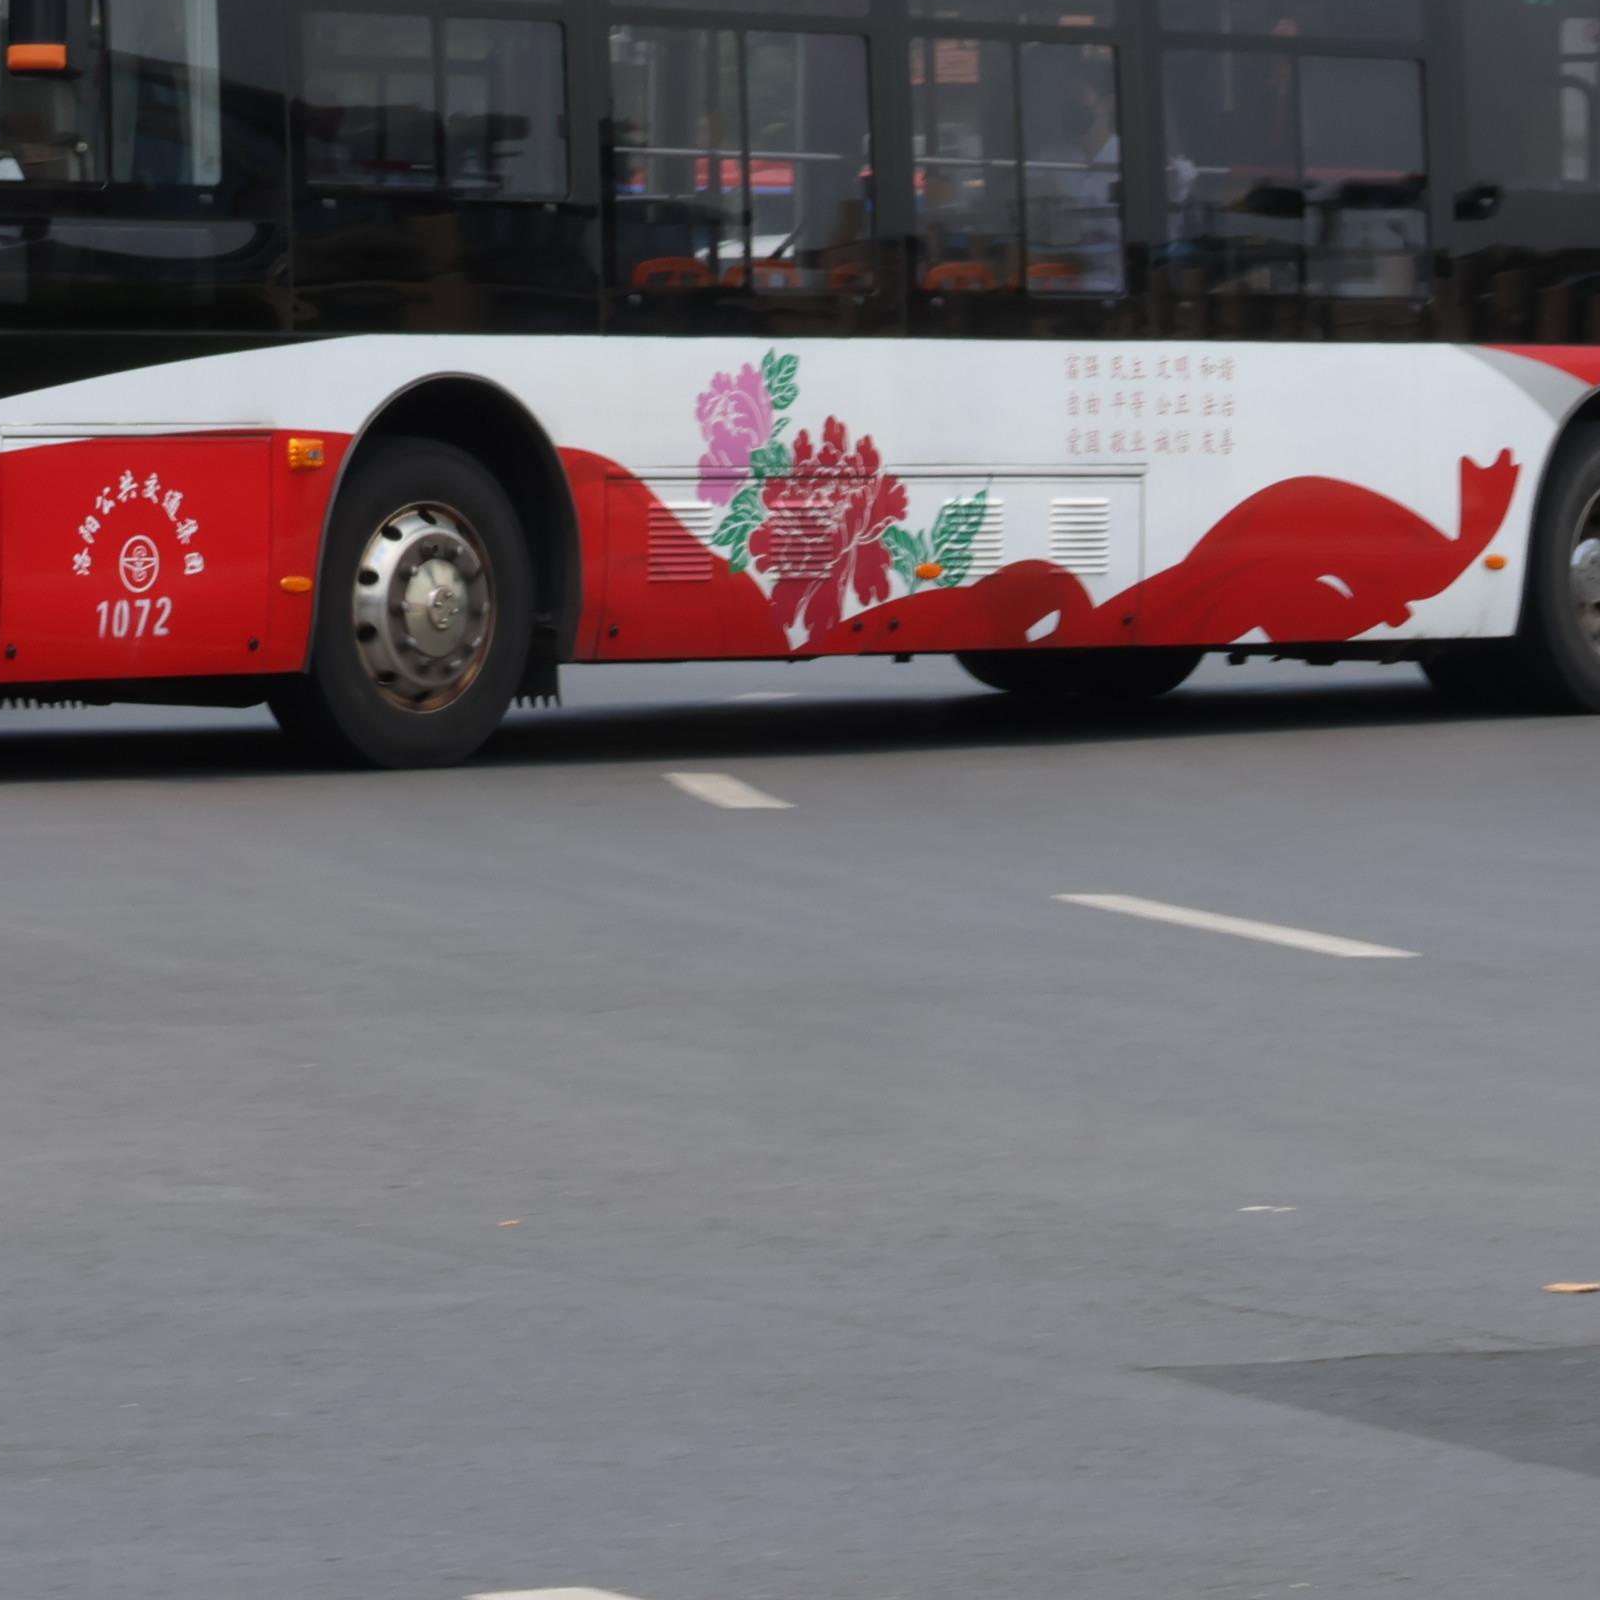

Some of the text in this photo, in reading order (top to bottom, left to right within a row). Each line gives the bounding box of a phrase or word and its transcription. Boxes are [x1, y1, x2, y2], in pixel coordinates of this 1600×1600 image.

[1111, 355, 1147, 380] 民主
[1156, 355, 1190, 380] 文明
[1200, 356, 1235, 380] 和谐
[1067, 391, 1101, 416] 自由
[1110, 391, 1146, 418] 平等
[1155, 393, 1190, 416] 公正
[96, 596, 172, 638] 1072
